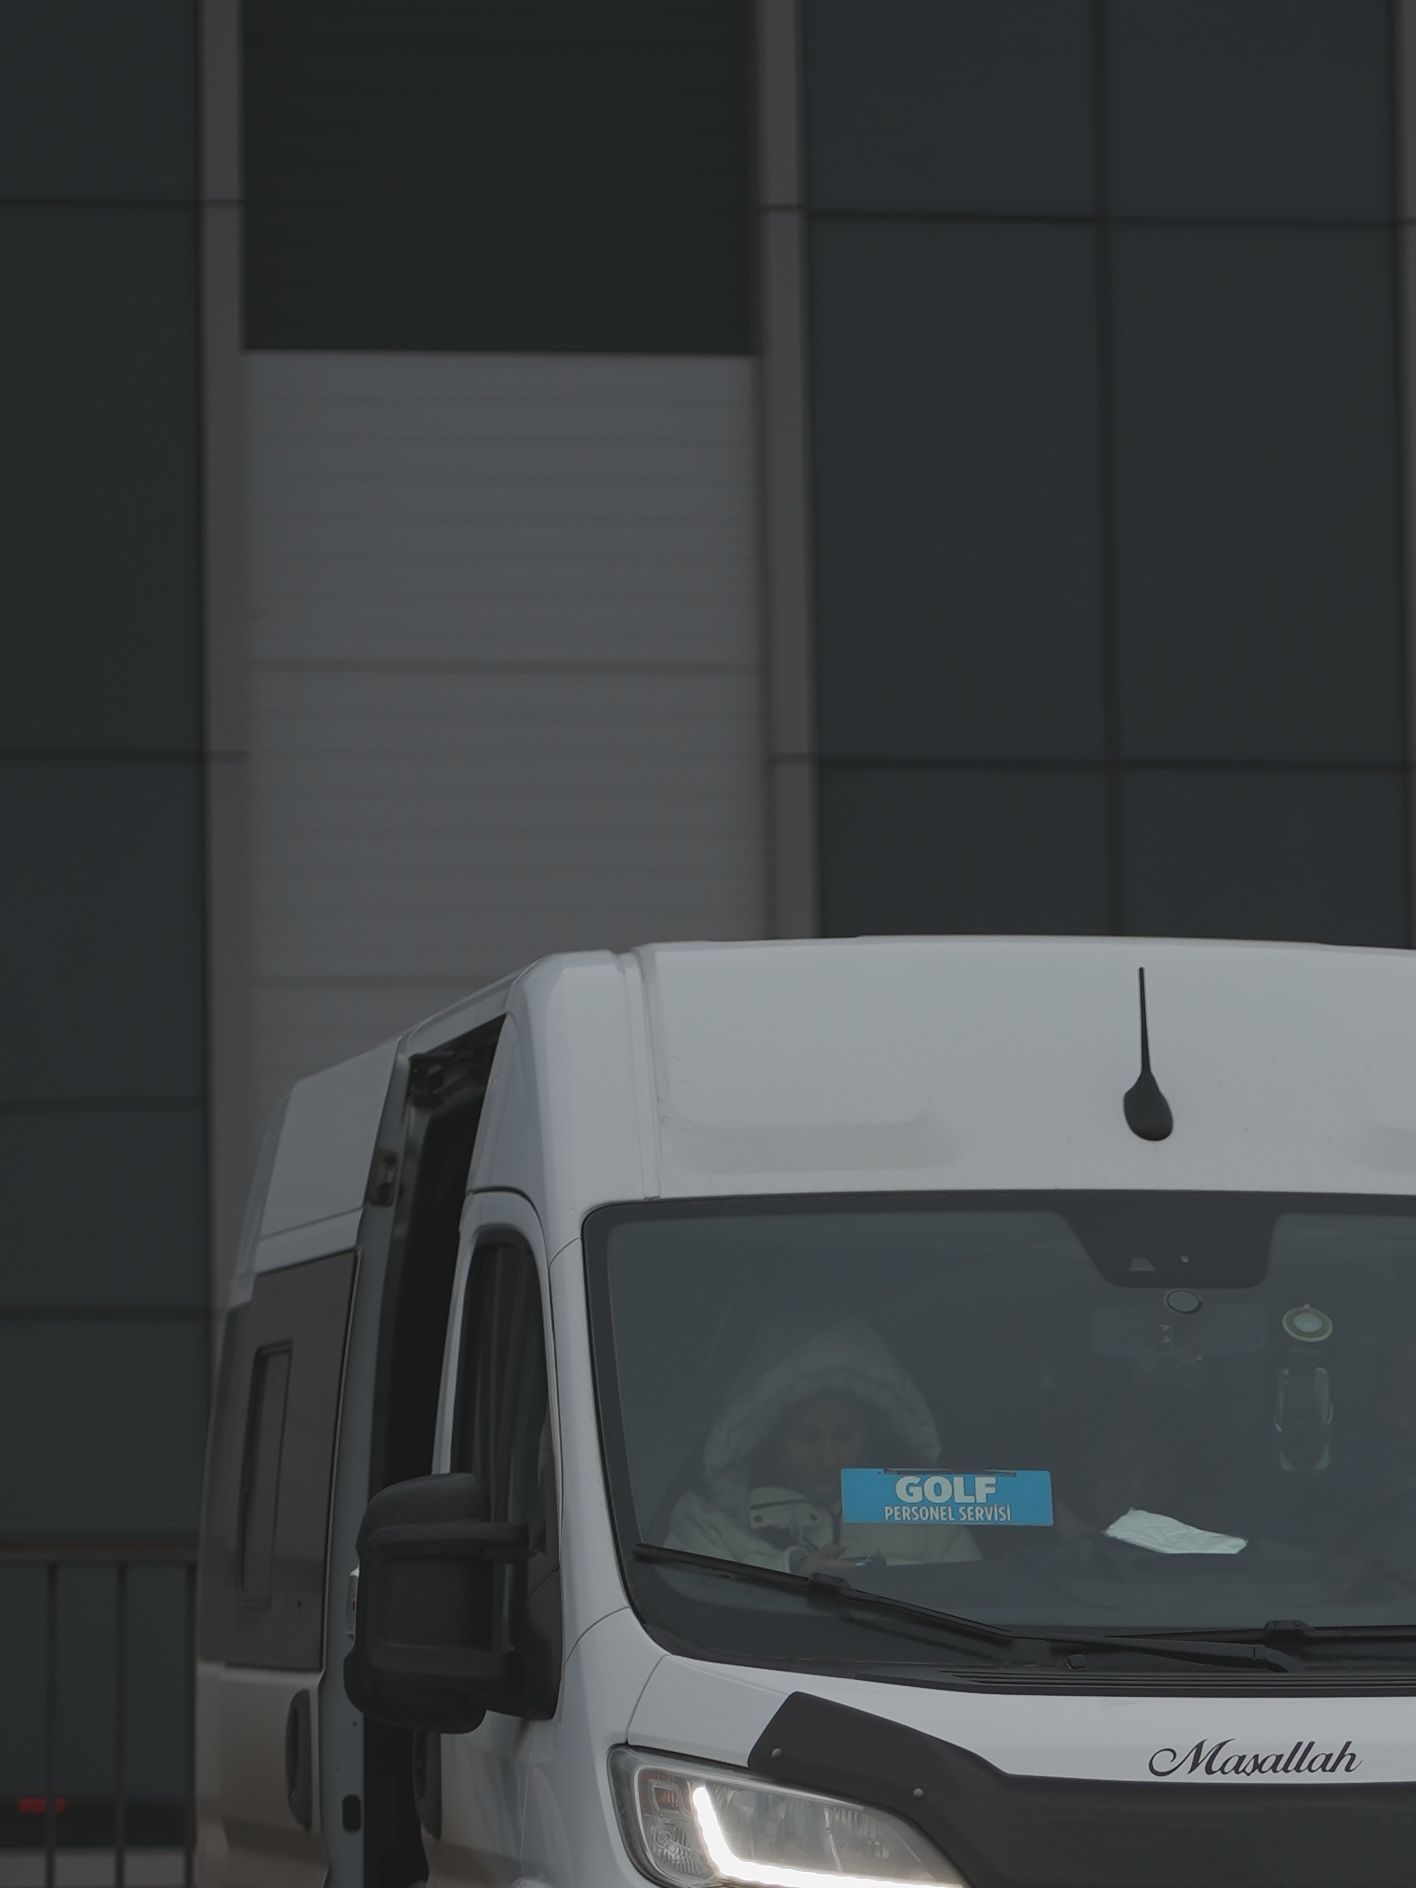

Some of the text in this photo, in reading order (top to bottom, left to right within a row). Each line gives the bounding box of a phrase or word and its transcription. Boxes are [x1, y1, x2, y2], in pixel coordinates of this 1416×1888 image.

[895, 1475, 998, 1503] GOLF
[884, 1503, 1012, 1521] PERSONEL SERVİSİ
[1148, 1737, 1363, 1777] Masallah
